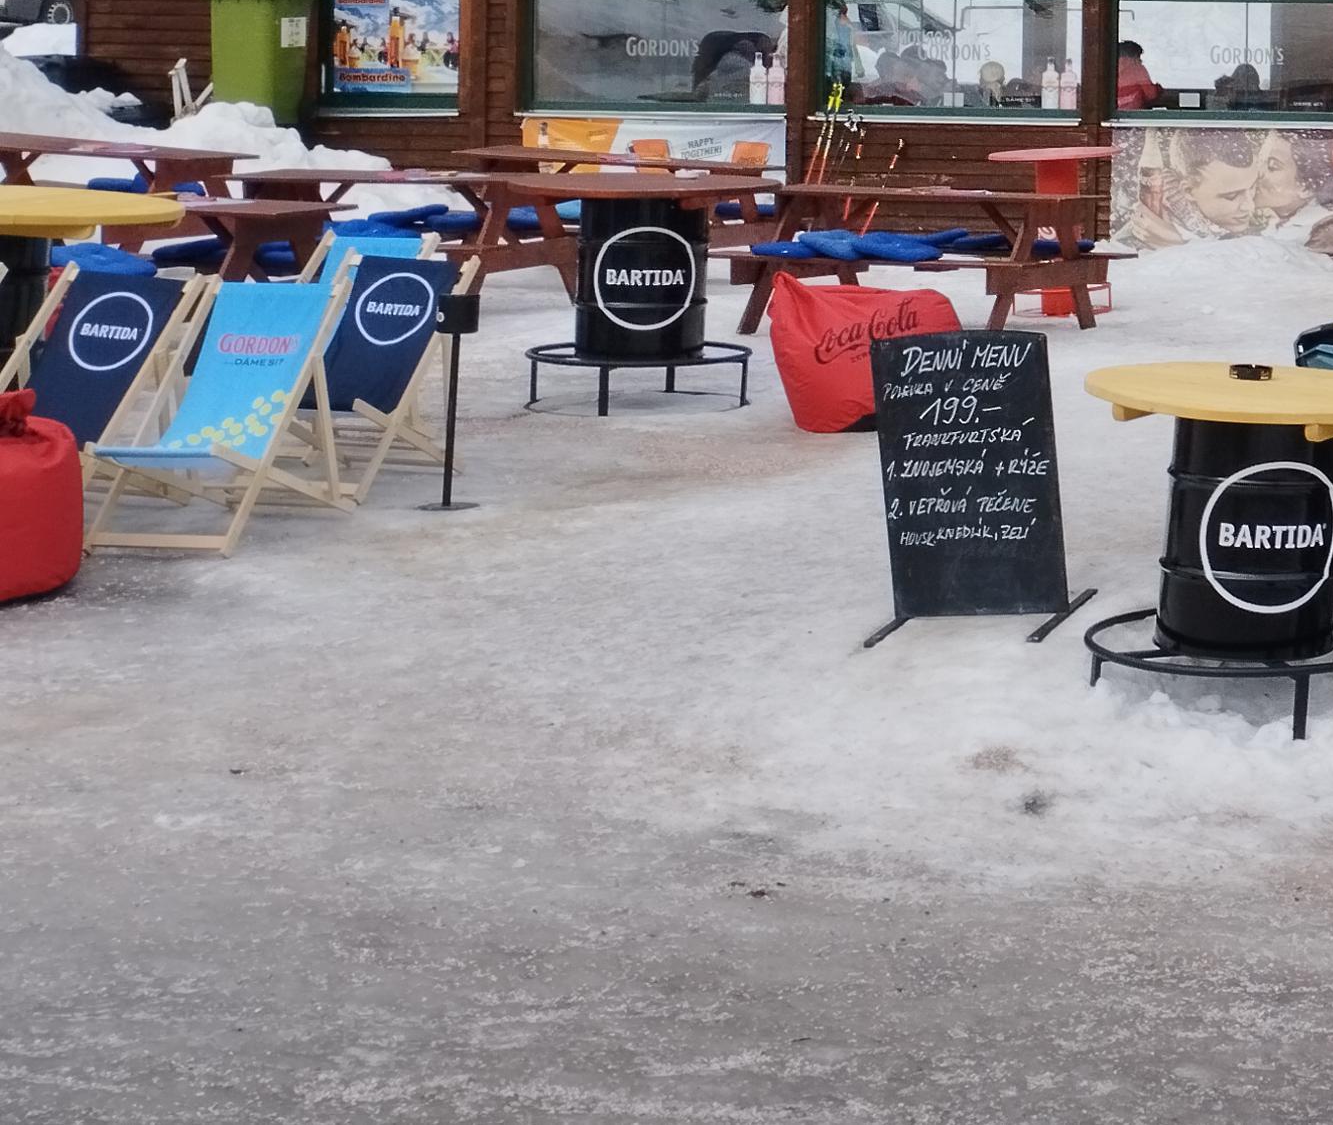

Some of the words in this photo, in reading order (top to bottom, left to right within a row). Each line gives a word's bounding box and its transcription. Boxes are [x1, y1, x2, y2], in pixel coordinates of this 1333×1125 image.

[605, 268, 685, 286] BARTIDA
[366, 301, 421, 317] BARTIDA
[79, 322, 139, 341] BARTIDA
[900, 339, 969, 377] DENNÍ
[971, 342, 1032, 369] MENU
[1218, 522, 1325, 549] BARTIDA
